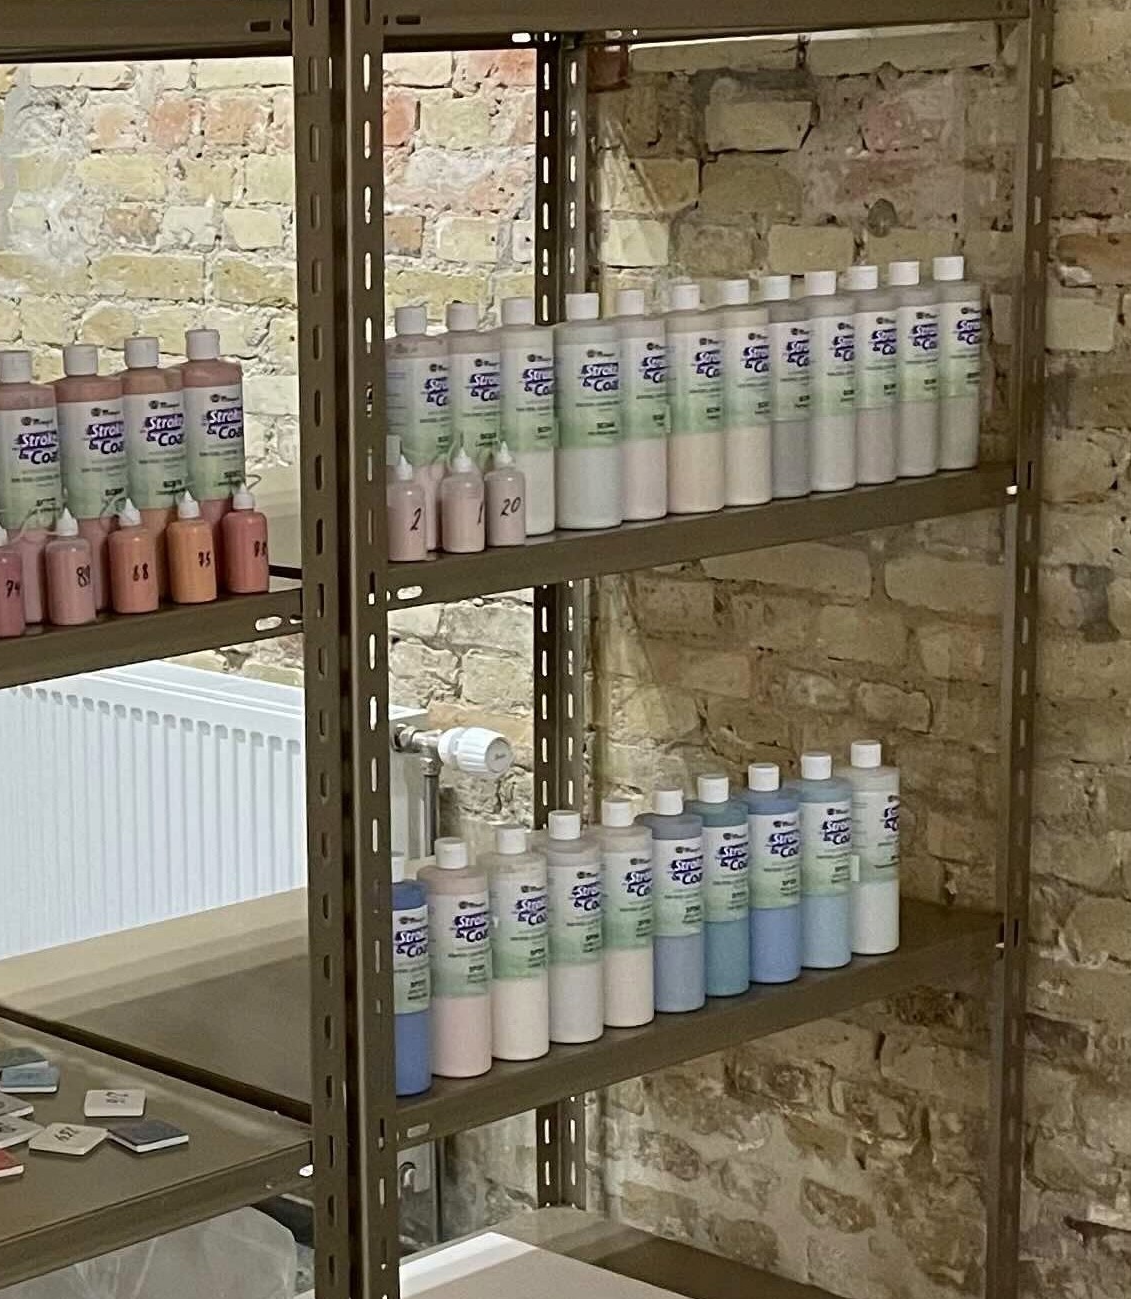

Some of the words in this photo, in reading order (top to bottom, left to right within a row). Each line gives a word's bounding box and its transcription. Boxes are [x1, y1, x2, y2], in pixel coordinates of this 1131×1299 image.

[474, 374, 500, 386] Stro
[92, 423, 124, 437] Stro
[500, 497, 521, 517] 20
[410, 508, 421, 531] 2
[773, 834, 799, 844] Stro
[676, 860, 702, 871] Stro
[400, 932, 428, 942] Stro
